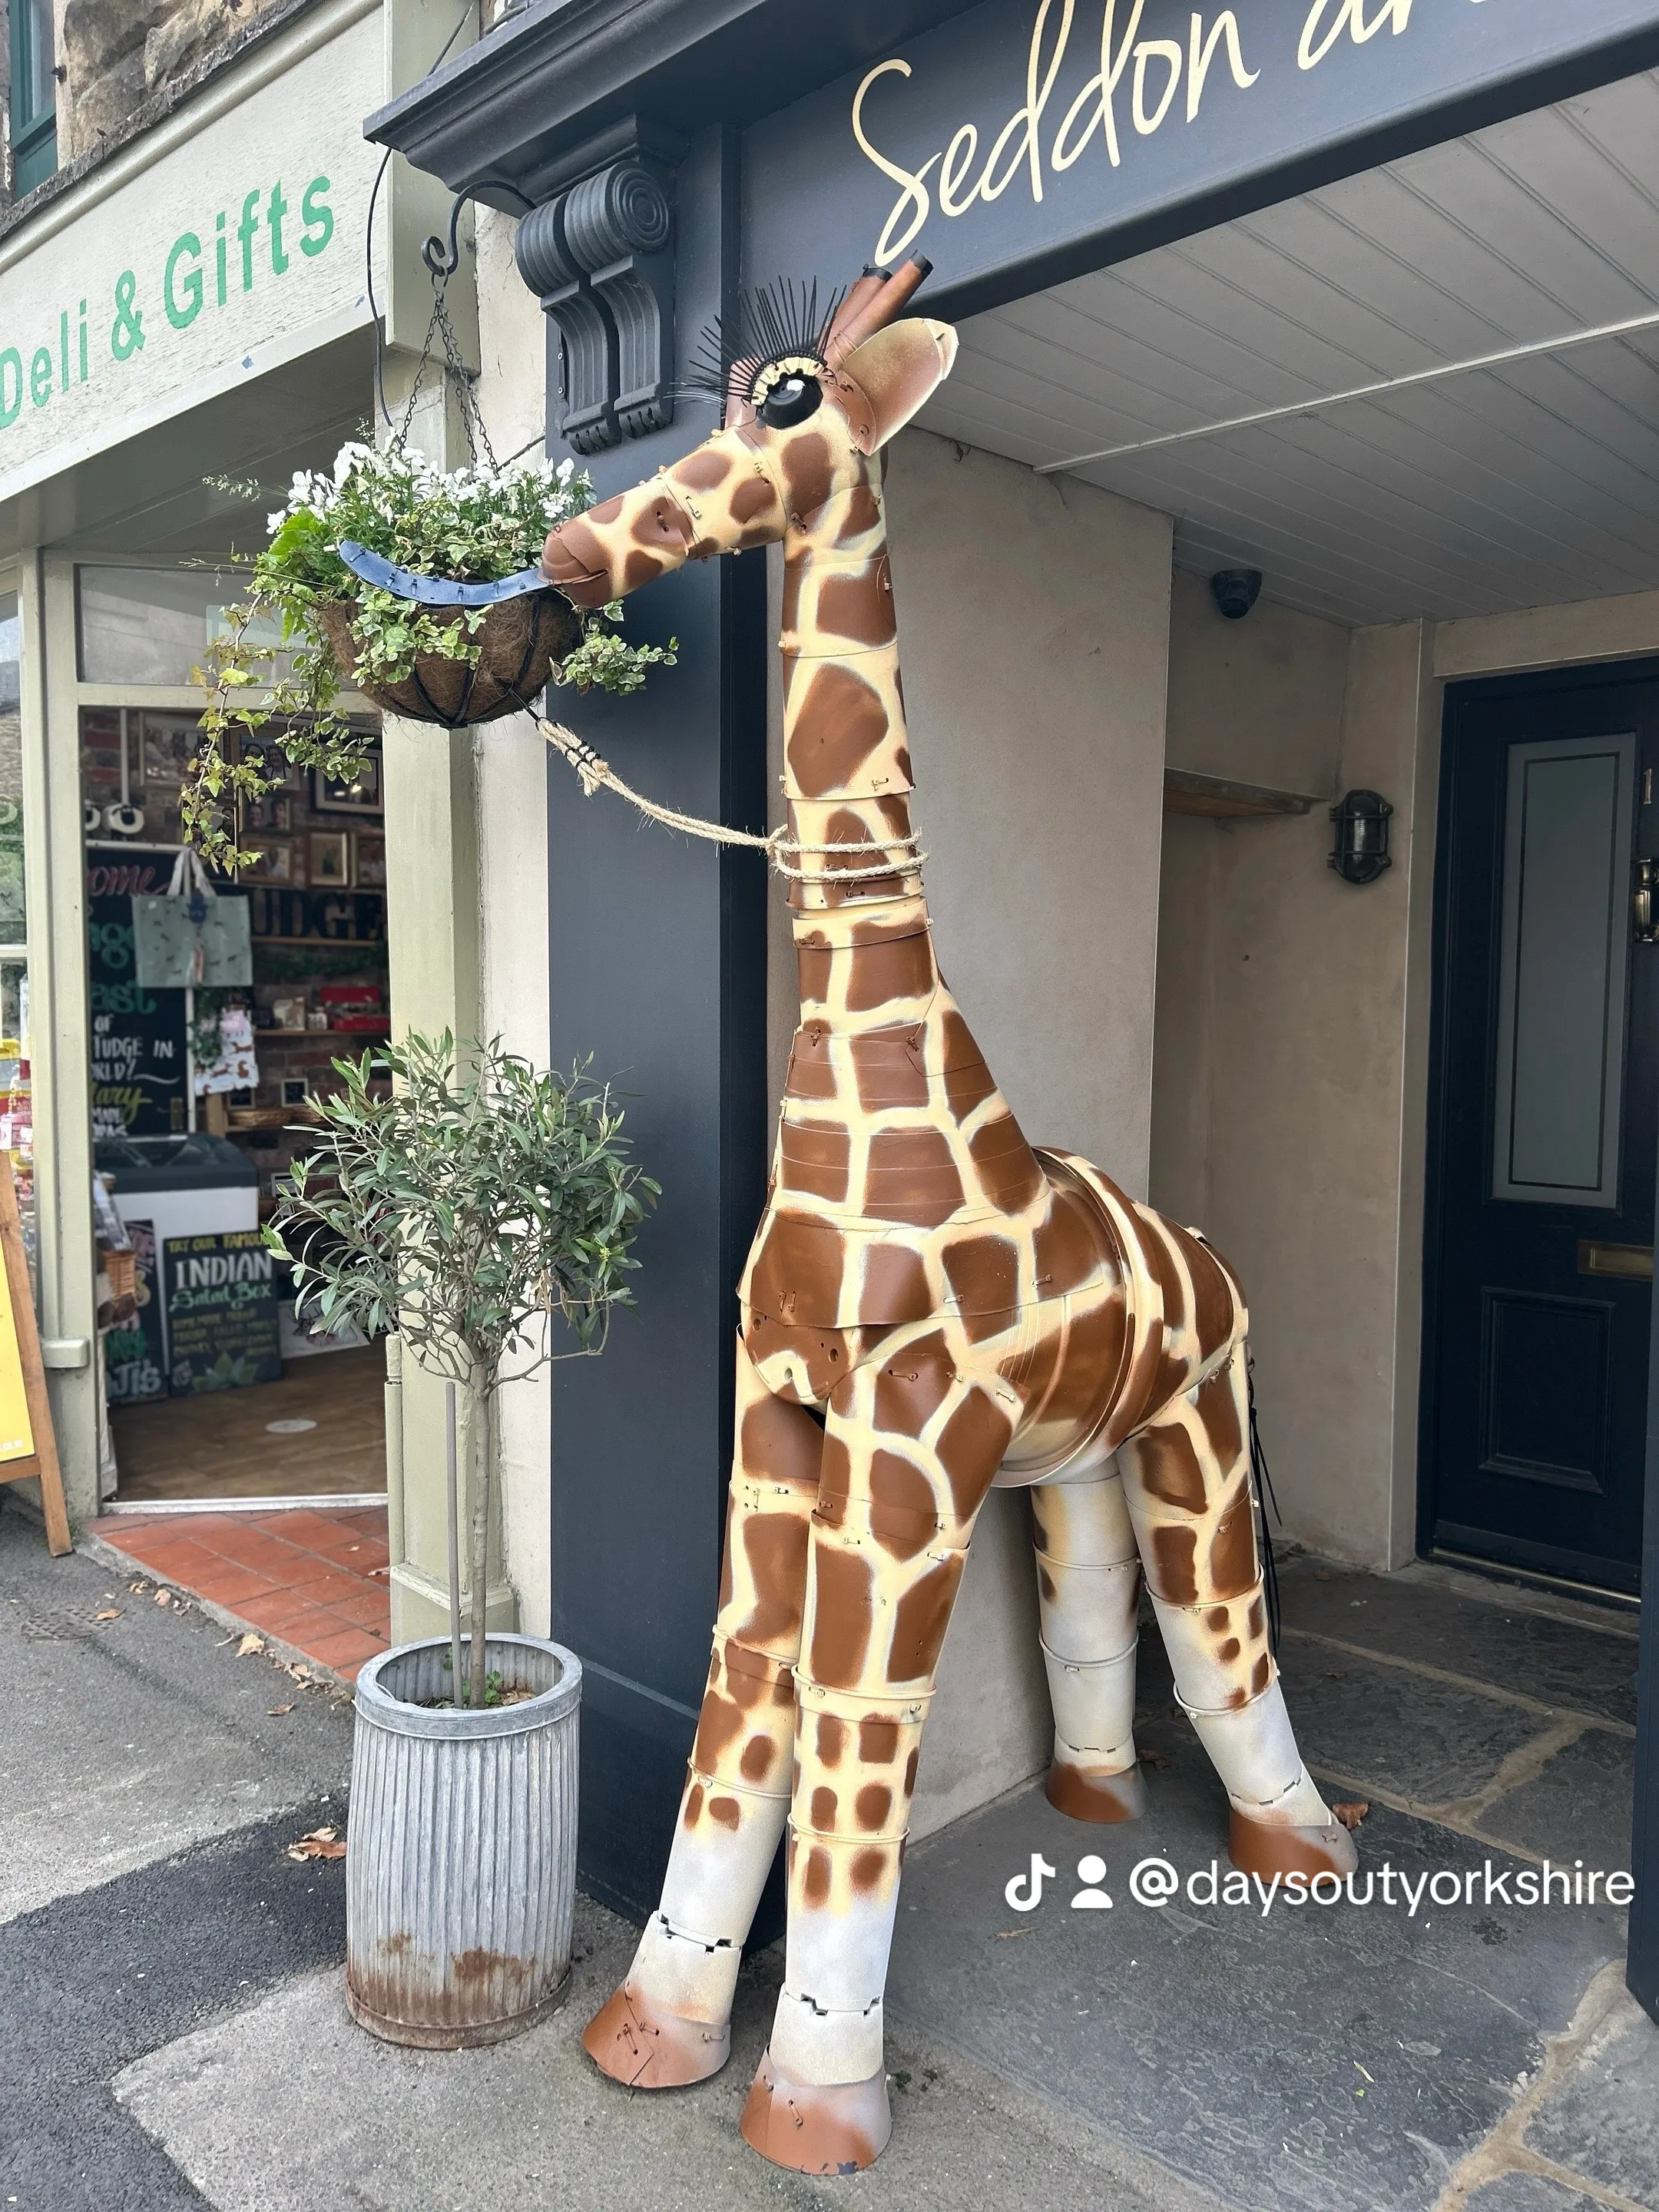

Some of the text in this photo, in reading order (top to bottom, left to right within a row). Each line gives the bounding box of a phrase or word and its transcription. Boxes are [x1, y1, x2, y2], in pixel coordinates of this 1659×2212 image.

[852, 0, 1261, 267] Seddon
[0, 176, 334, 430] Deli & Gifts
[1643, 769, 1652, 806] 1
[250, 888, 382, 939] UDGE
[221, 1231, 263, 1249] FAMOU
[175, 1251, 272, 1291] INDIAN
